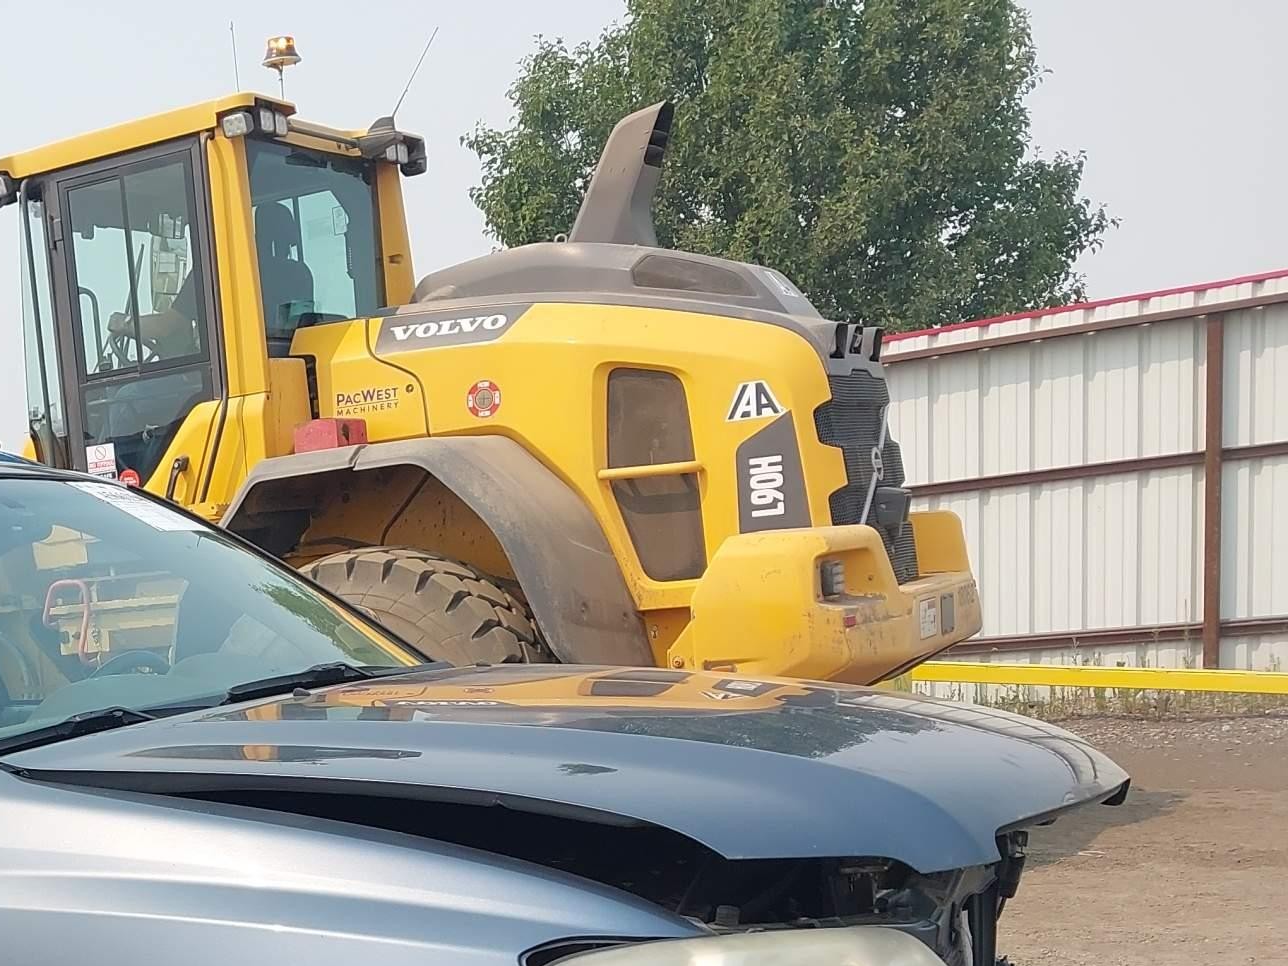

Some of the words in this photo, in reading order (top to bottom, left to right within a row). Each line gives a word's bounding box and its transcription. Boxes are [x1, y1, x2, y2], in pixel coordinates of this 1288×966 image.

[390, 314, 507, 341] VOLVO
[337, 402, 399, 416] MACHINERY
[749, 455, 785, 518] L90H
